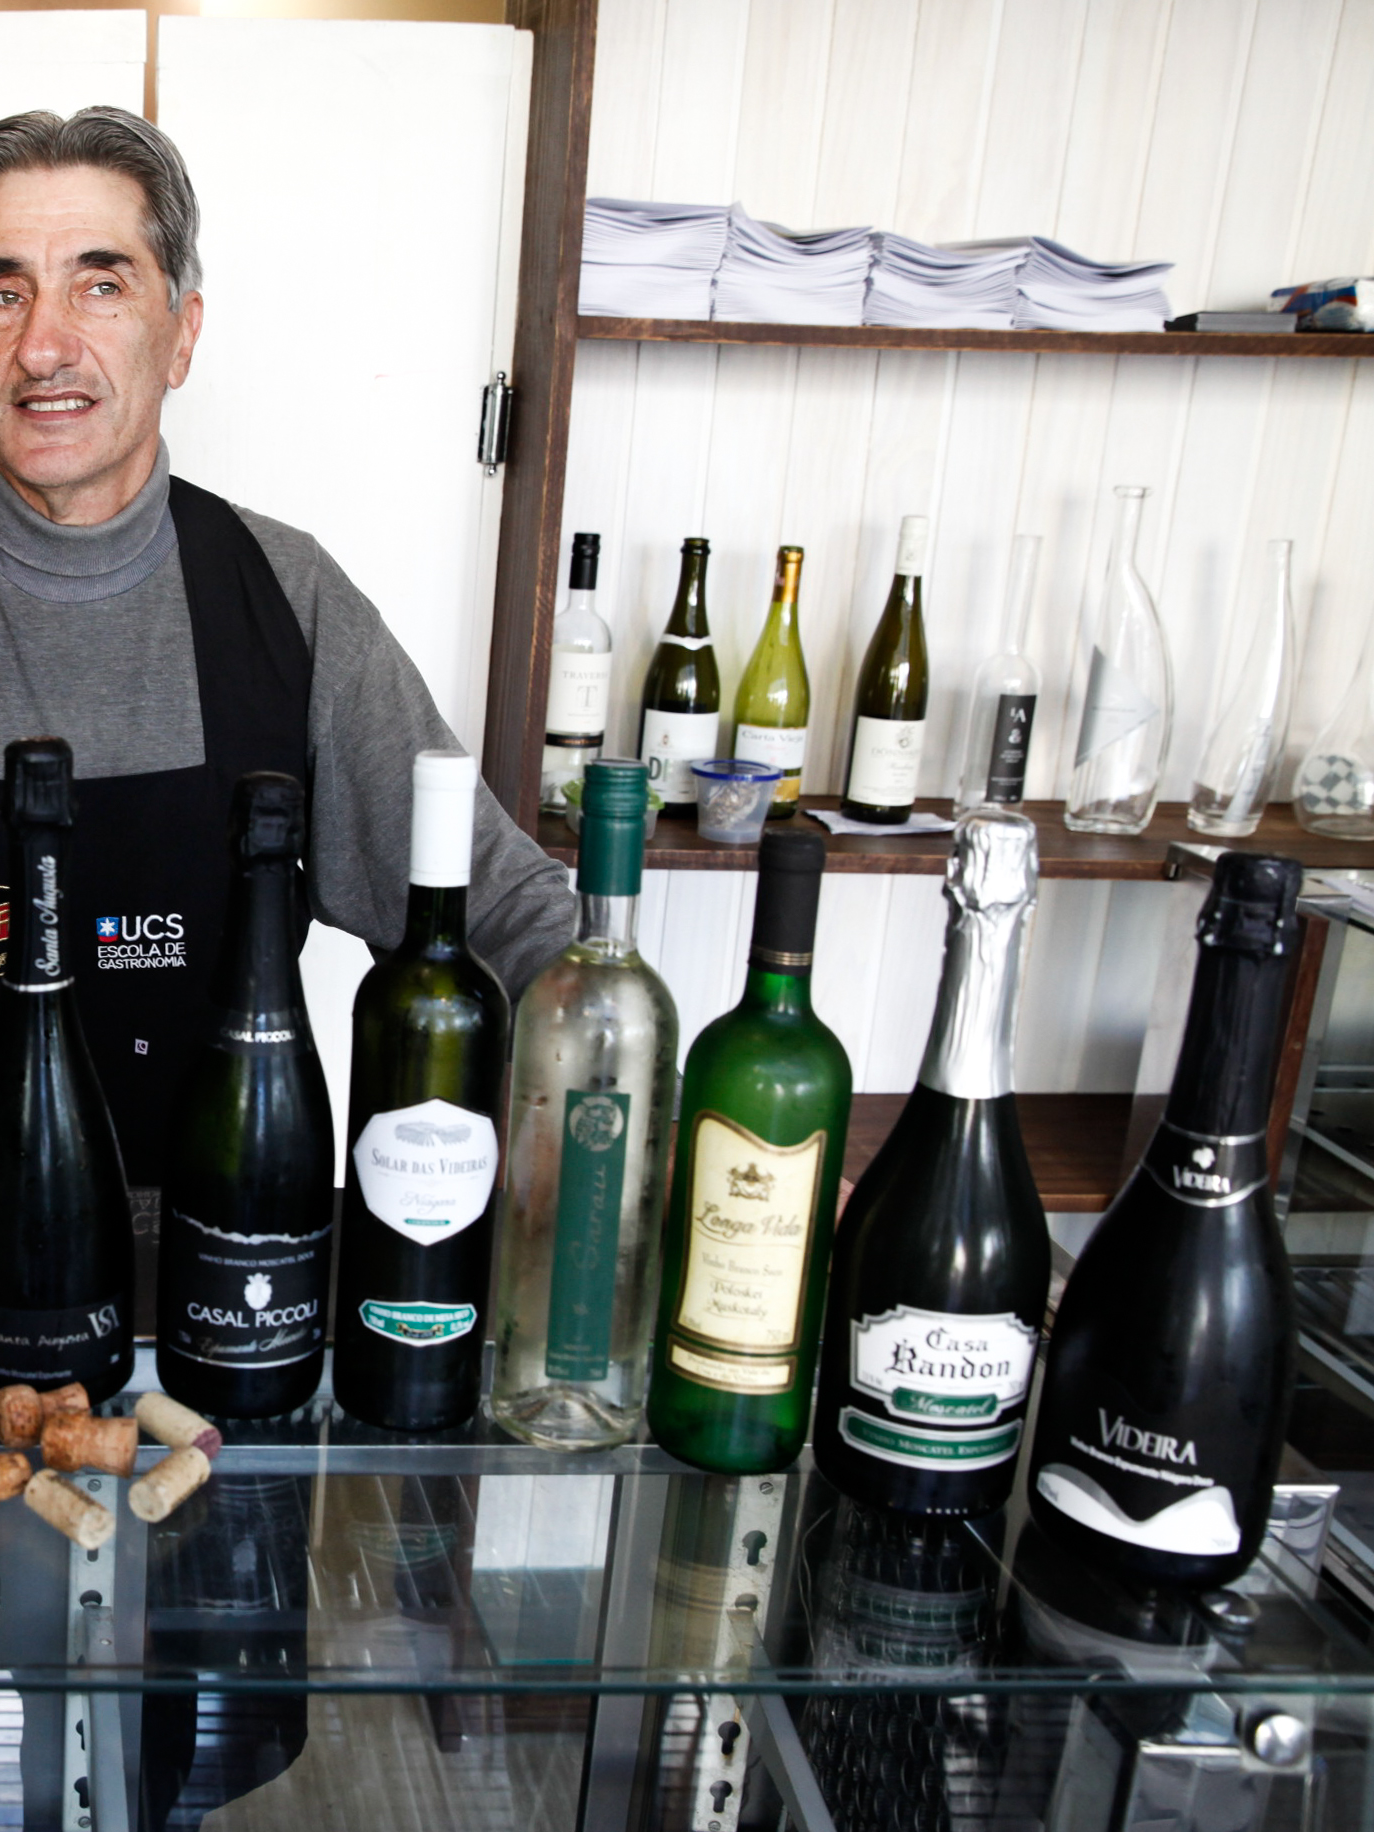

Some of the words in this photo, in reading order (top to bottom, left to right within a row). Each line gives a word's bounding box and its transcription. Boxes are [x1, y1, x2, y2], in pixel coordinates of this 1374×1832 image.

[741, 730, 775, 742] Carta
[32, 855, 64, 925] Augusta
[121, 913, 184, 941] UCS
[34, 927, 61, 977] Santa
[97, 943, 162, 958] ESCOLA
[164, 942, 186, 956] DE
[97, 956, 186, 969] GASTRONOMIA
[371, 1147, 408, 1172] SOLAR
[411, 1160, 435, 1174] DAS
[439, 1155, 488, 1175] VIDEIRAS
[1173, 1164, 1231, 1194] VIDEIRA
[694, 1201, 754, 1240] Longa
[187, 1302, 250, 1328] CASAL
[255, 1299, 318, 1328] PICCOLI
[925, 1326, 989, 1351] Casa
[884, 1338, 1011, 1380] Randon
[910, 1394, 993, 1416] Moscatel
[898, 1438, 955, 1456] MOSCATEL
[1099, 1407, 1199, 1466] VIDEIRA
